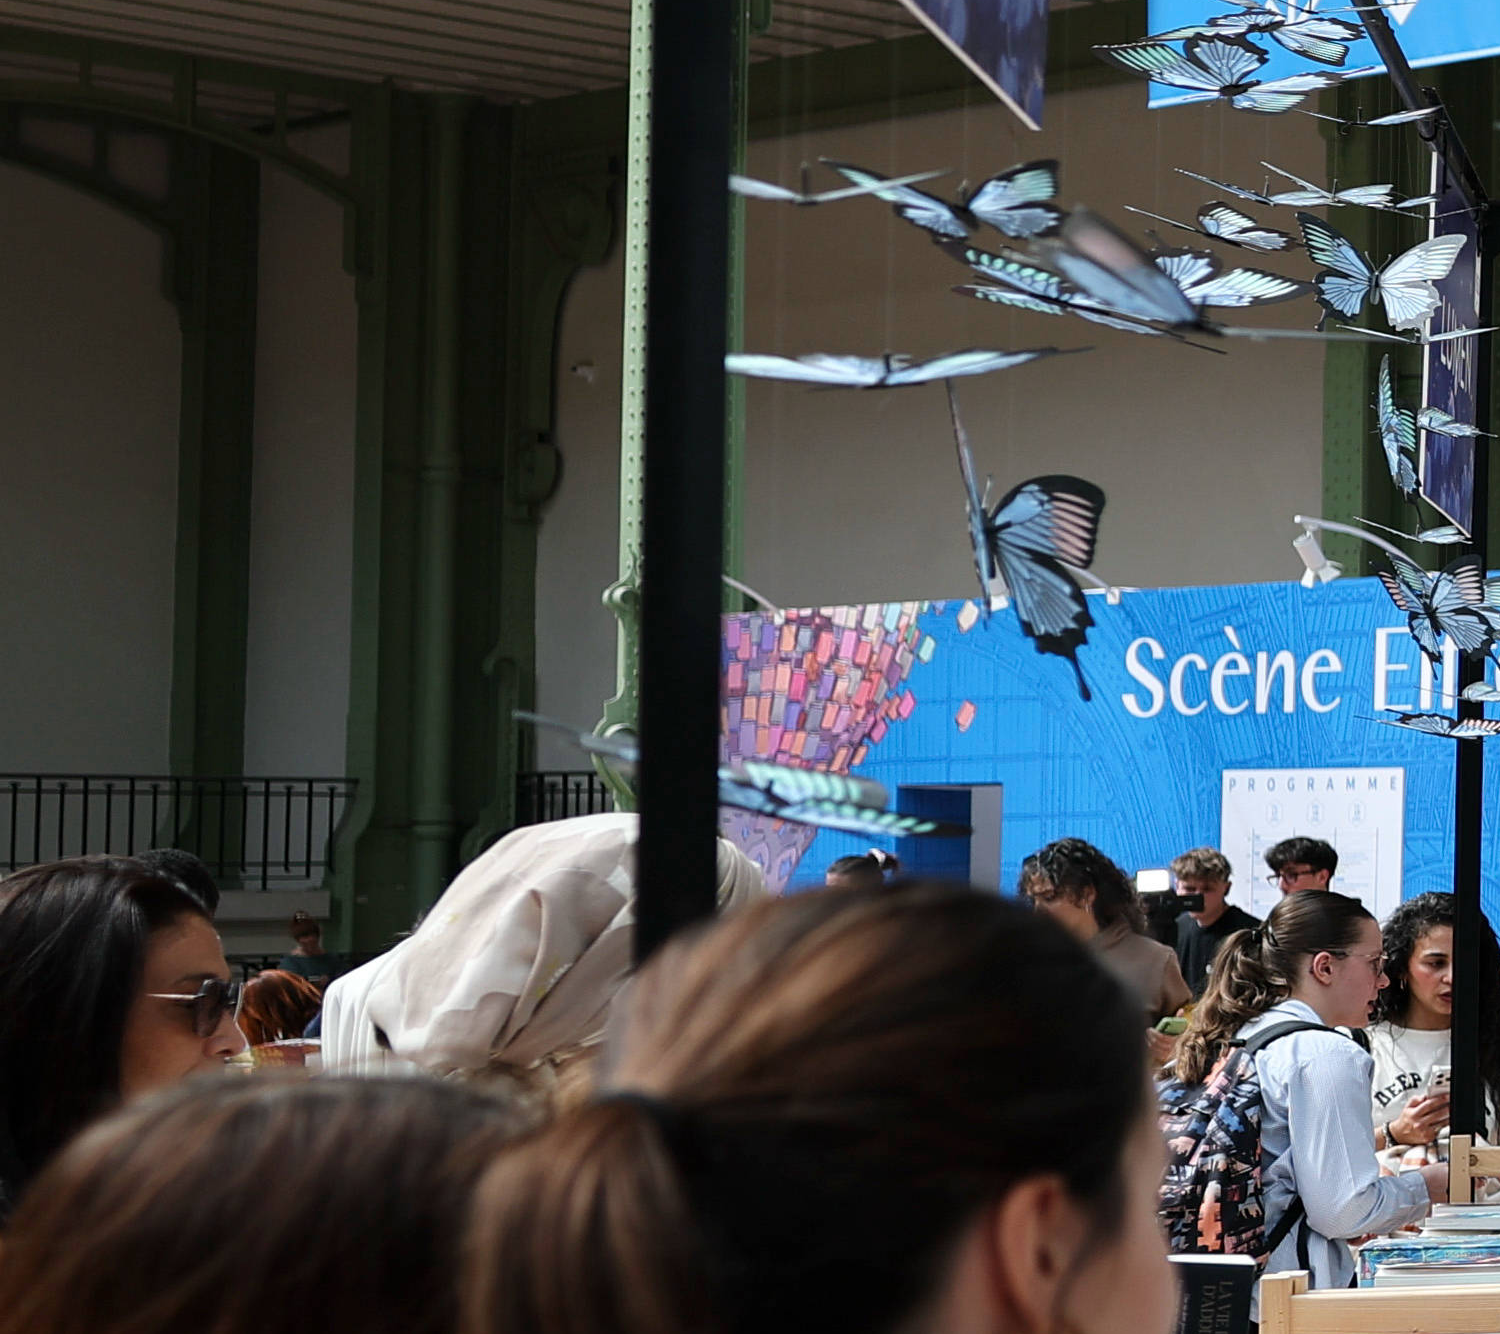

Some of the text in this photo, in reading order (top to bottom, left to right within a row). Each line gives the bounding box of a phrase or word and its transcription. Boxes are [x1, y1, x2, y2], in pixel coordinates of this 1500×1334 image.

[1121, 626, 1342, 718] Scène
[1229, 777, 1397, 792] PROGRAMME
[1374, 1072, 1422, 1107] DEEP
